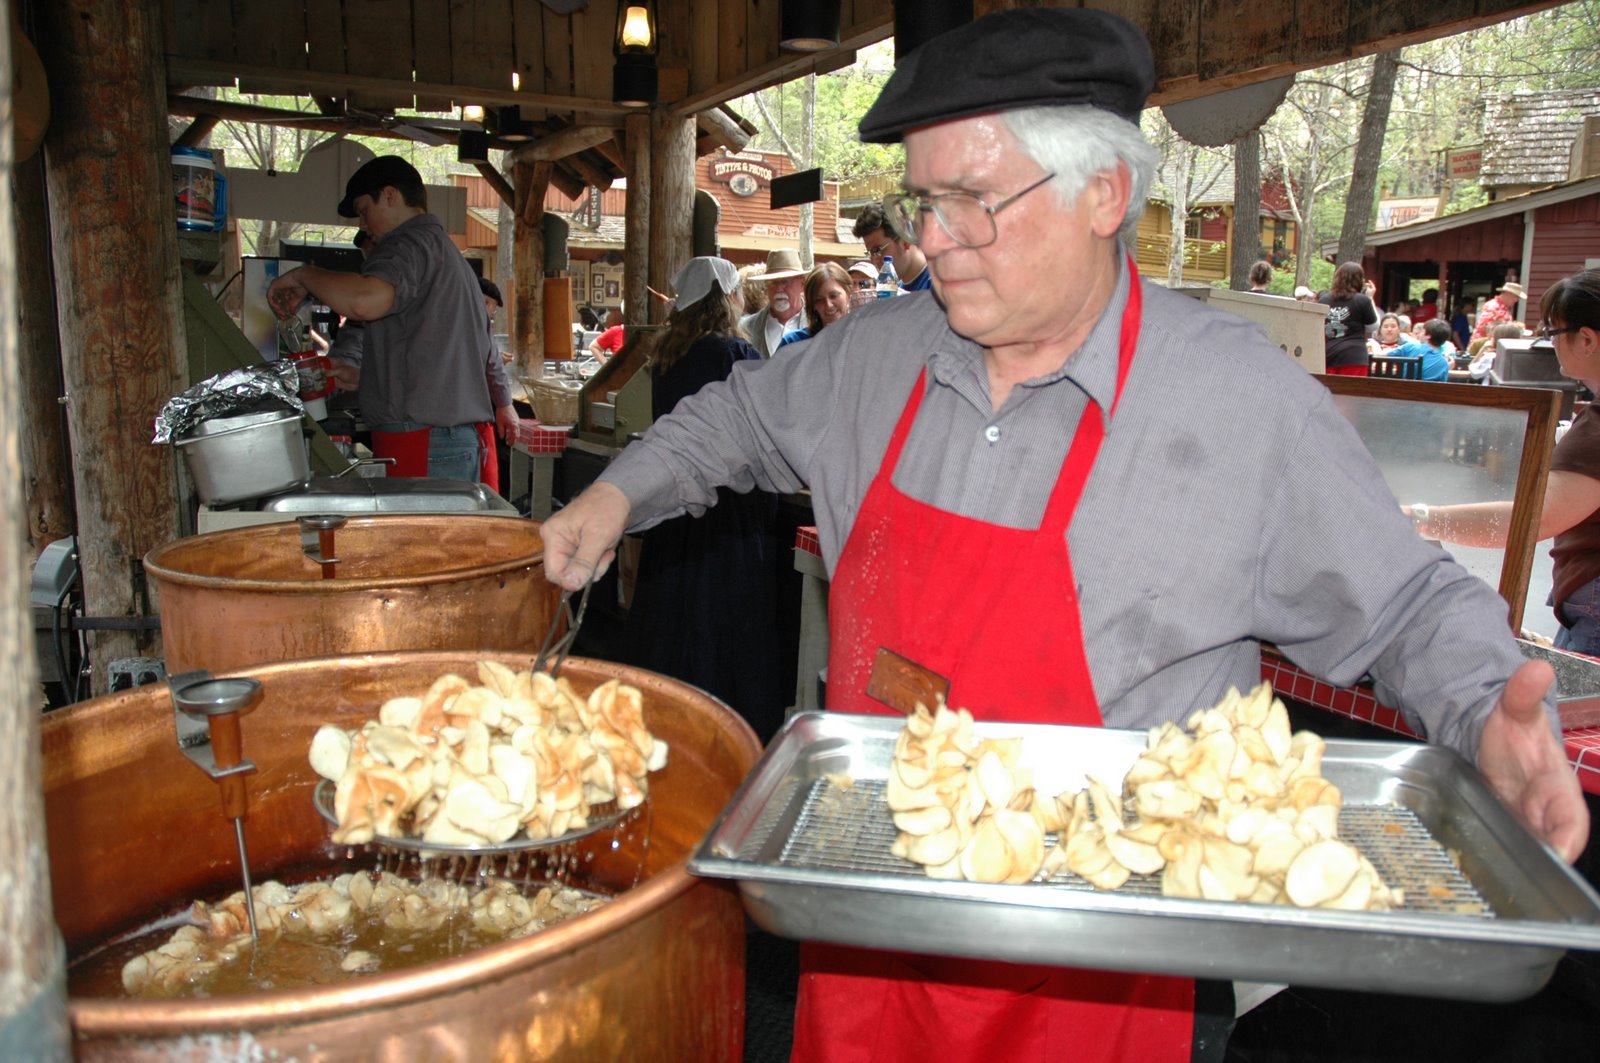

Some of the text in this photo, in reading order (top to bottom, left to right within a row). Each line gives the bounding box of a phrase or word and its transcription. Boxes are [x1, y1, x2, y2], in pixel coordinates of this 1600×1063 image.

[714, 162, 773, 181] TINTYPE & PHOTOS
